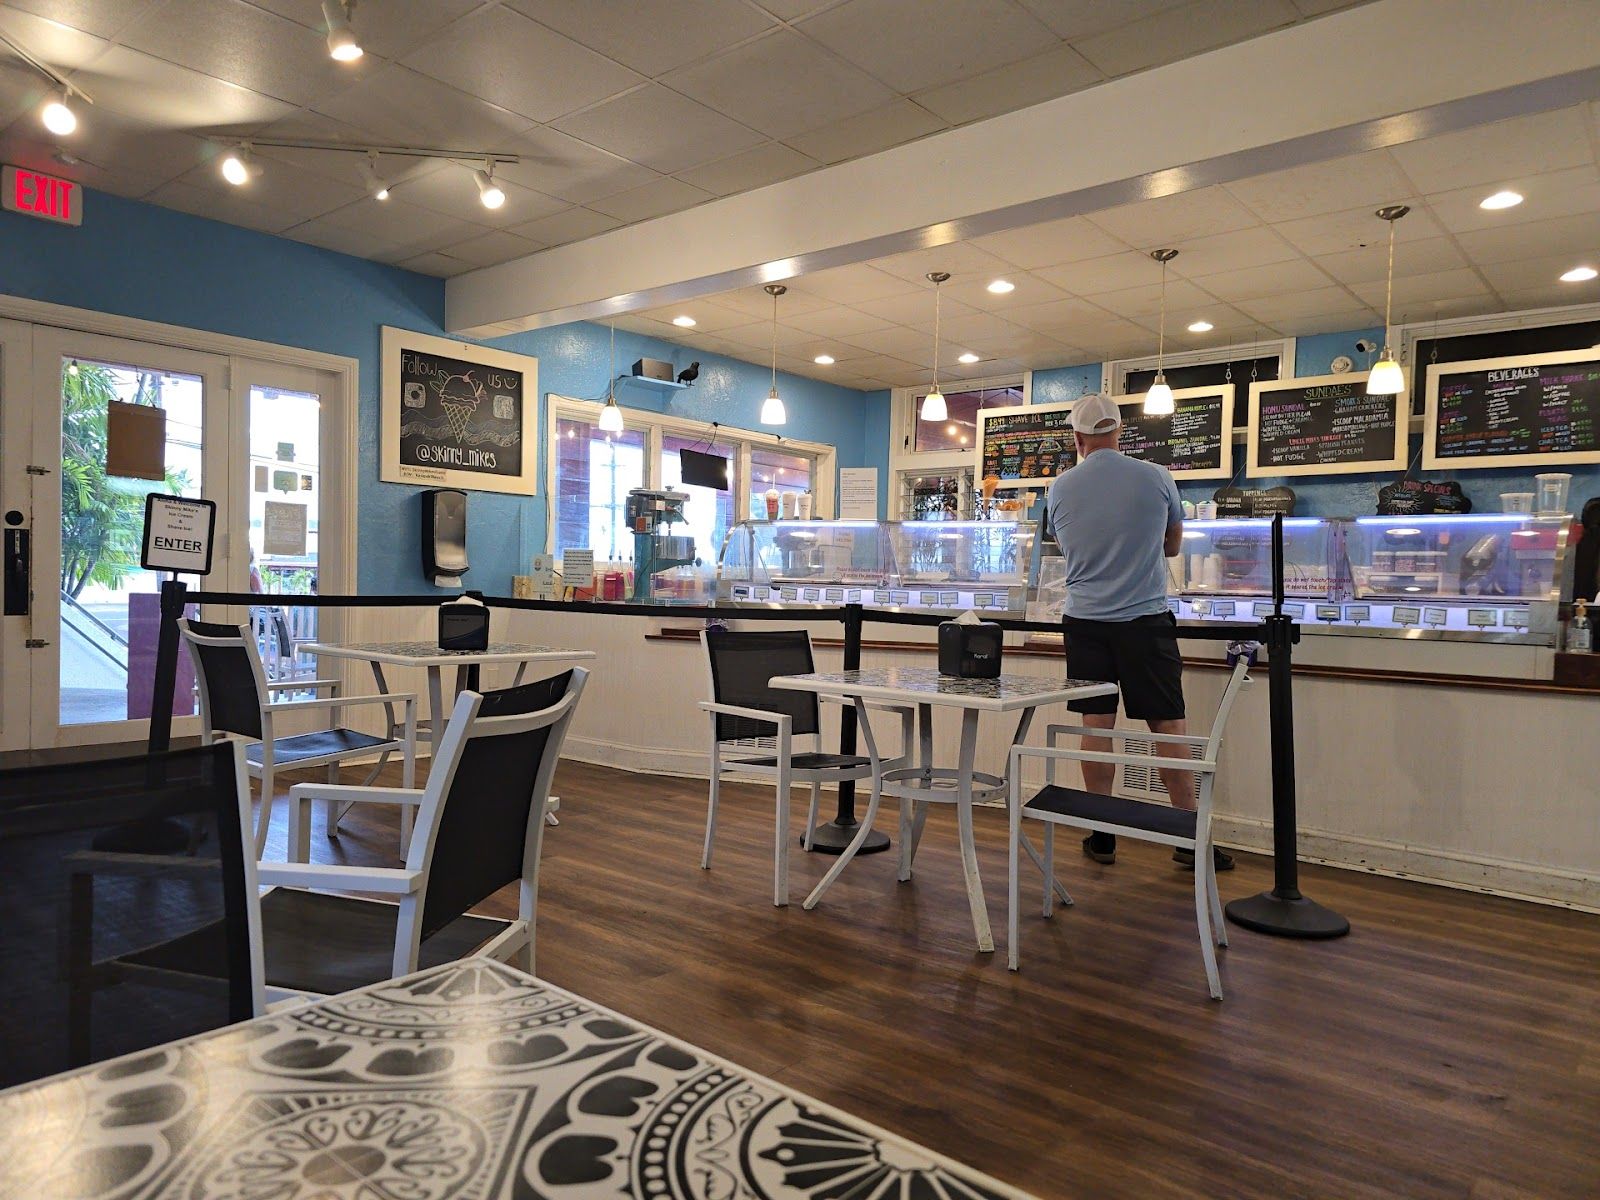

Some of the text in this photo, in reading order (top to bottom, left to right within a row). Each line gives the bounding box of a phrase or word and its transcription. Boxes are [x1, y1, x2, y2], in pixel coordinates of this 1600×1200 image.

[15, 169, 75, 220] EXIT
[402, 354, 438, 376] Follow
[1488, 367, 1540, 382] BEVERAGES
[1008, 415, 1029, 424] SHAVE
[1031, 413, 1042, 424] ICE
[1285, 453, 1305, 461] FUDGE
[154, 536, 202, 551] ENTER
